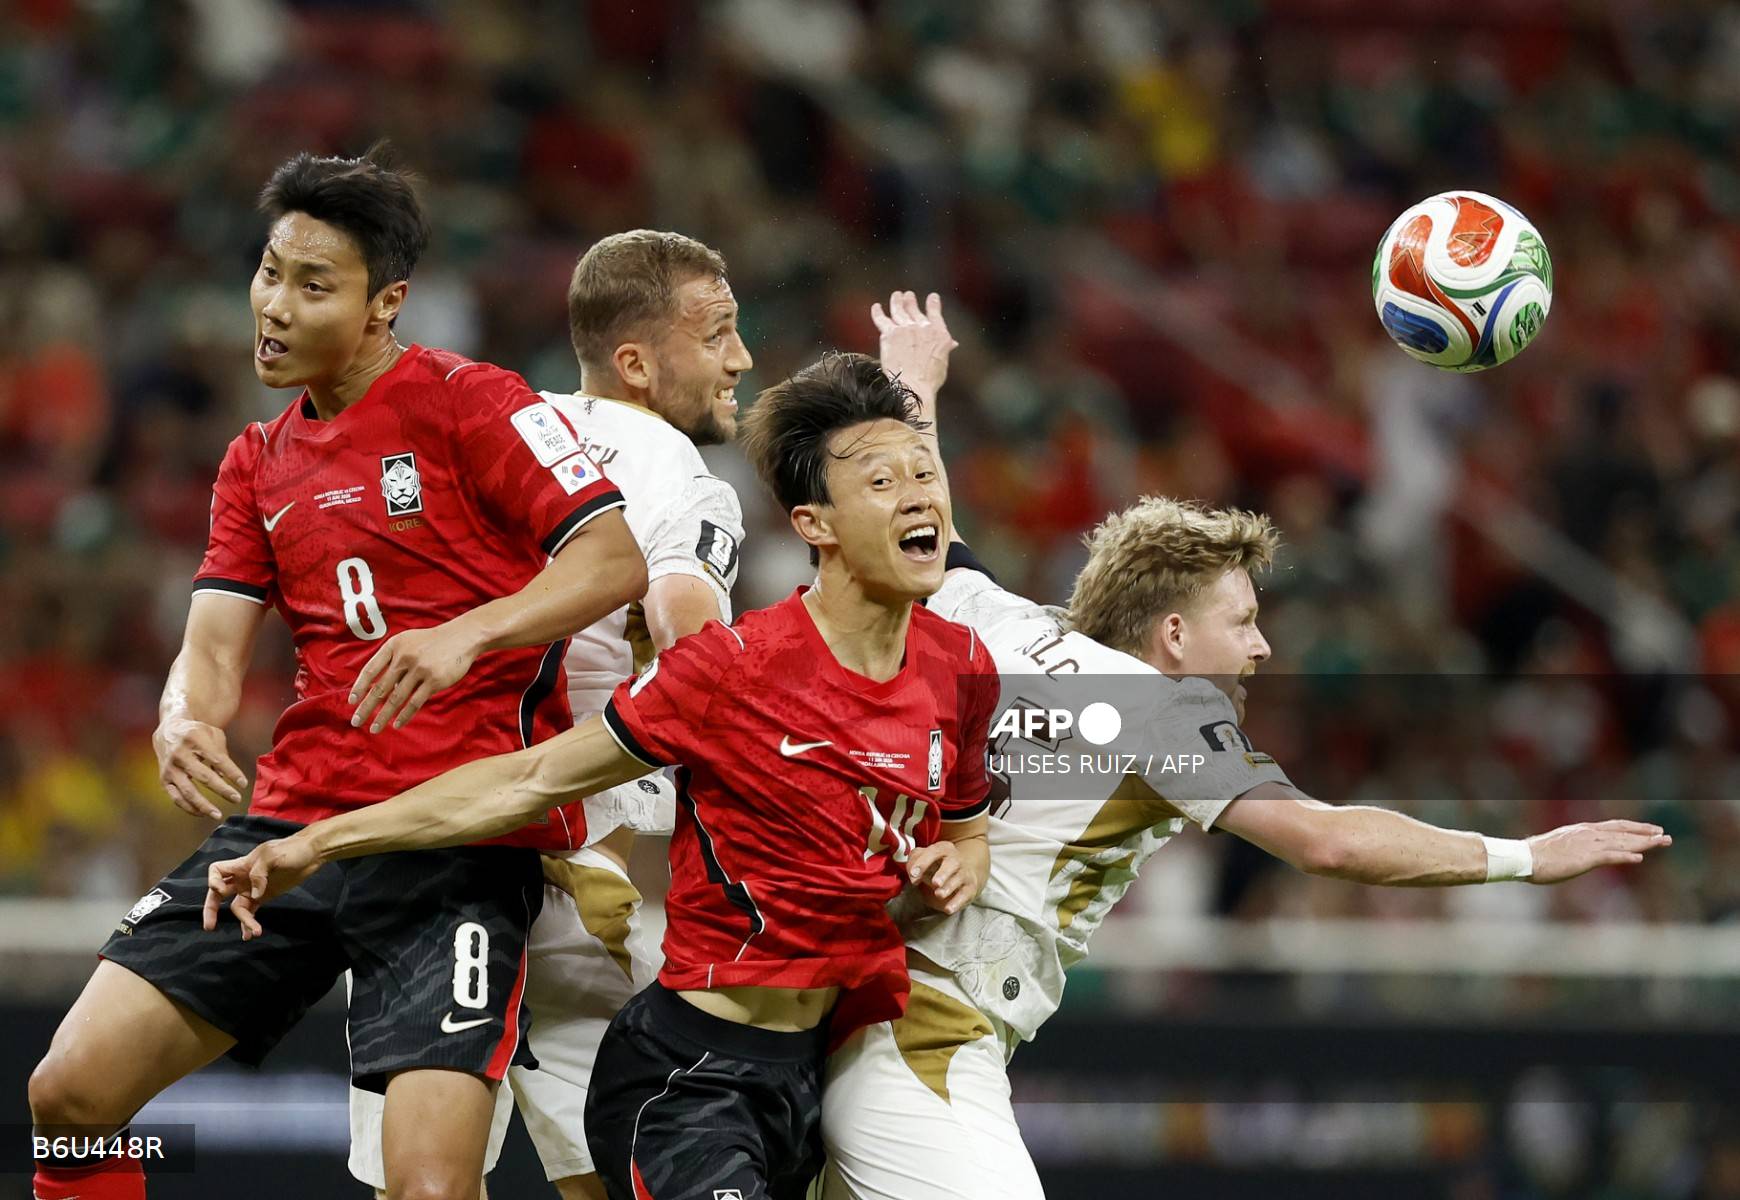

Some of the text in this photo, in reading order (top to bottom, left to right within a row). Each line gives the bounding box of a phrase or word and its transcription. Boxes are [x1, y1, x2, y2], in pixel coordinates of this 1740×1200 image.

[389, 517, 423, 532] KORE
[336, 557, 388, 641] 8
[452, 920, 490, 1010] 8
